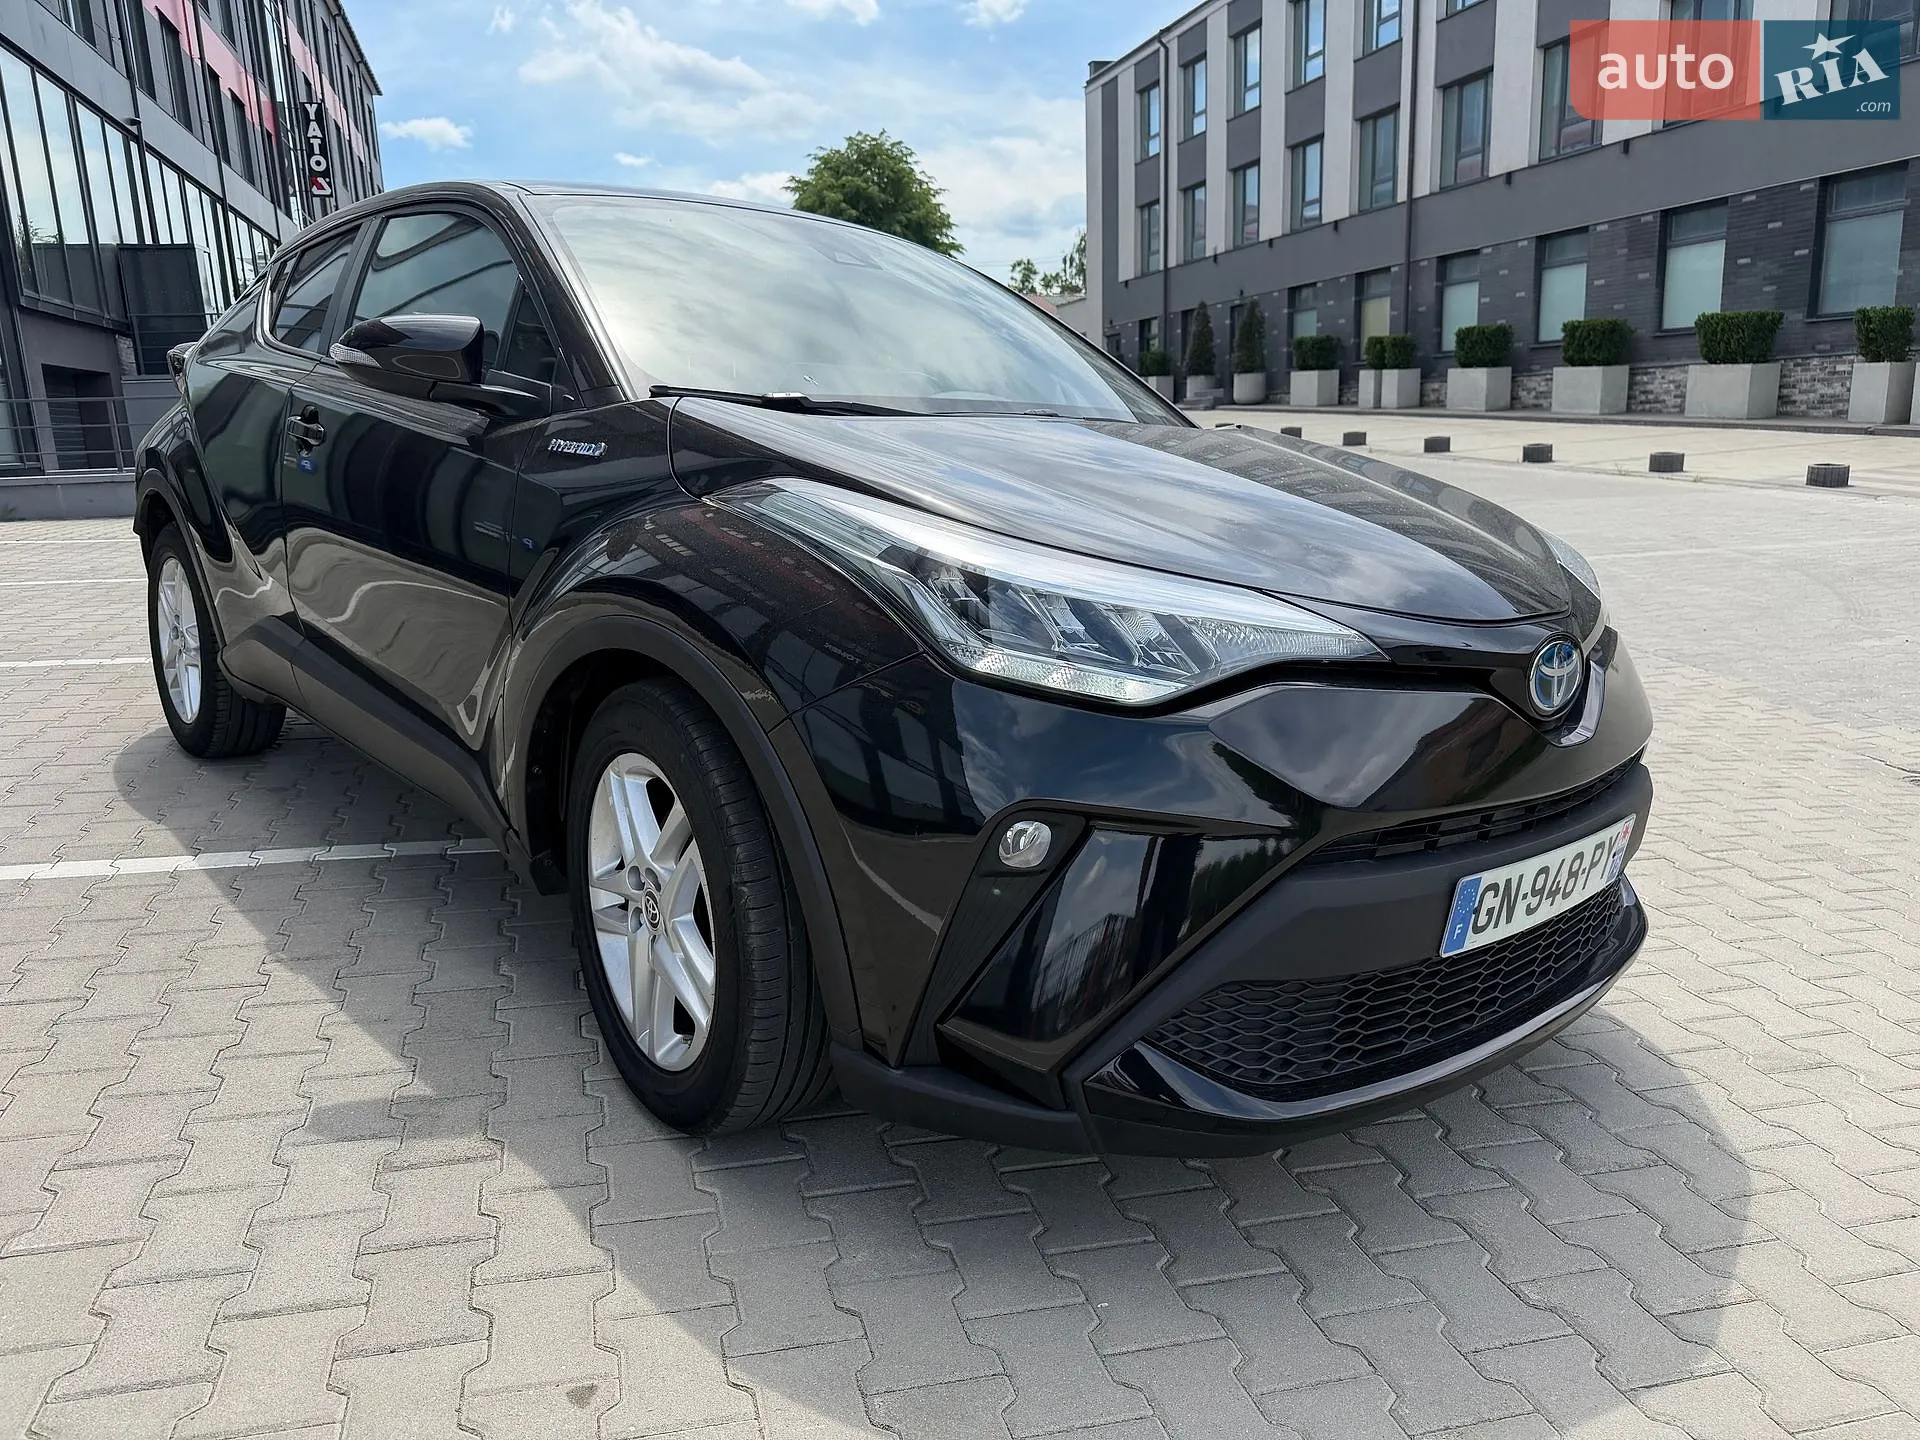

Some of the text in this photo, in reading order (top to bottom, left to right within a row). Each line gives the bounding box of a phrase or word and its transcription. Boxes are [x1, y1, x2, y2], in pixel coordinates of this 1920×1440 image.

[304, 104, 327, 172] YATO
[1471, 831, 1621, 935] GN-948-PY
[1453, 923, 1463, 940] F
